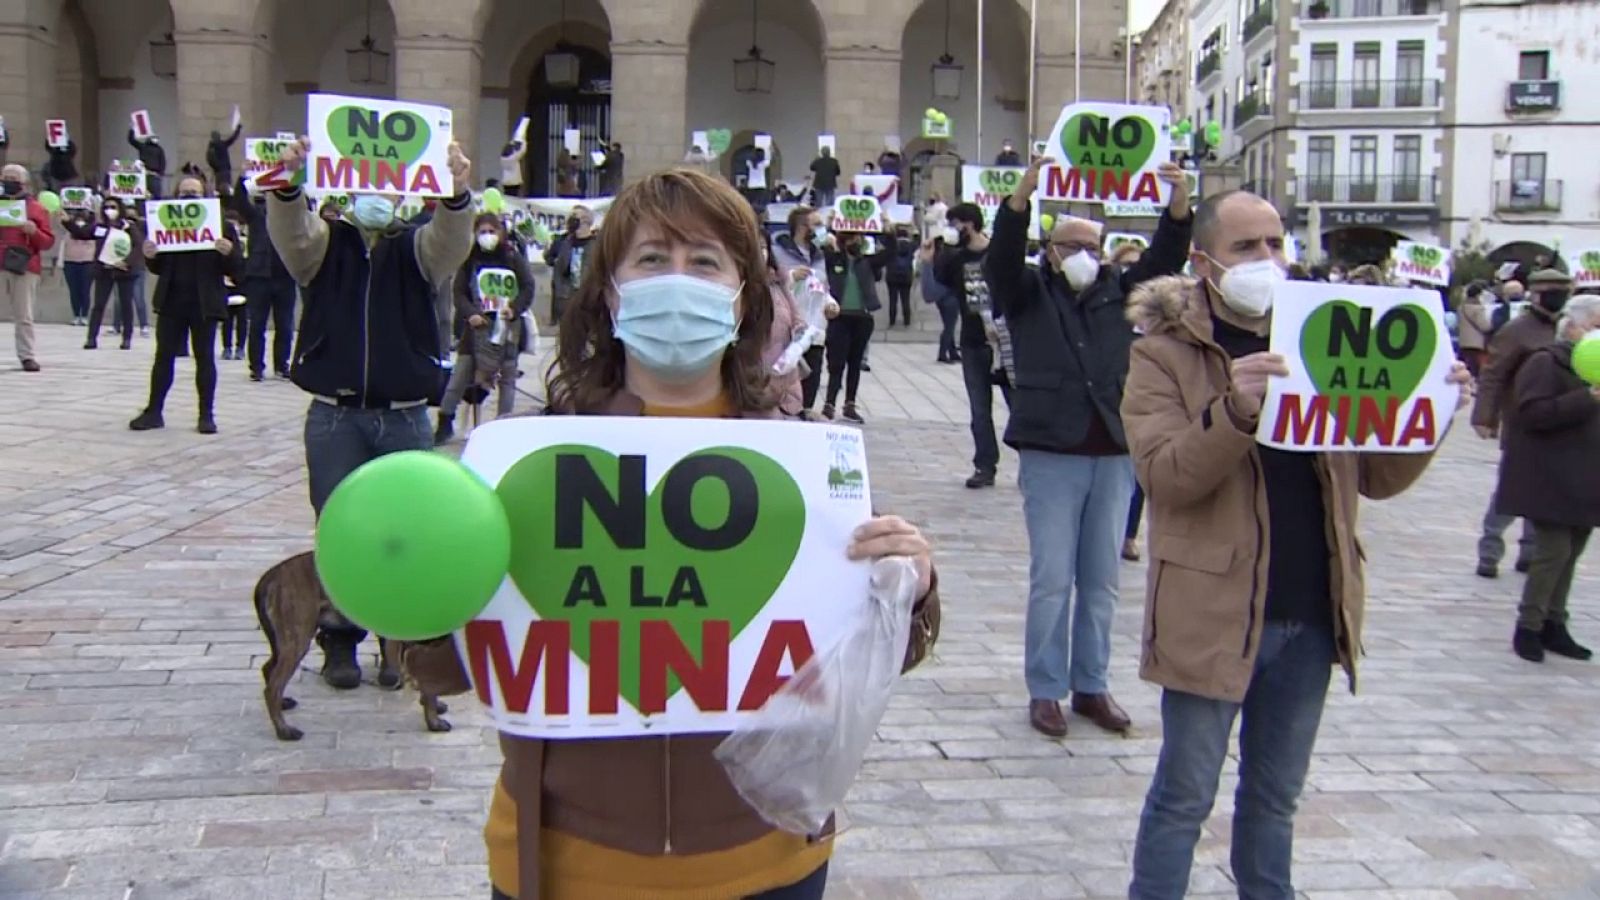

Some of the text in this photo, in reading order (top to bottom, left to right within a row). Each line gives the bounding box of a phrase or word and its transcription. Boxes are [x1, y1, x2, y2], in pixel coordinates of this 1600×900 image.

[1515, 95, 1552, 105] VENDE
[49, 123, 63, 144] F
[348, 109, 416, 142] NO
[1078, 113, 1142, 149] NO
[351, 142, 399, 159] A LA
[1080, 152, 1124, 167] A LA
[316, 156, 442, 194] MINA
[988, 170, 1016, 185] NO
[1046, 166, 1161, 204] MINA
[167, 203, 200, 219] NO
[845, 199, 870, 211] NO
[835, 218, 878, 230] MINA
[155, 227, 215, 245] MINA
[1413, 245, 1437, 260] NO
[1400, 261, 1442, 279] MINA
[488, 273, 515, 290] NO
[1327, 305, 1419, 360] NO
[1329, 366, 1391, 390] A LA
[1271, 394, 1436, 446] MINA
[554, 454, 760, 552] NO
[563, 565, 708, 608] A LA
[464, 619, 820, 715] MINA
